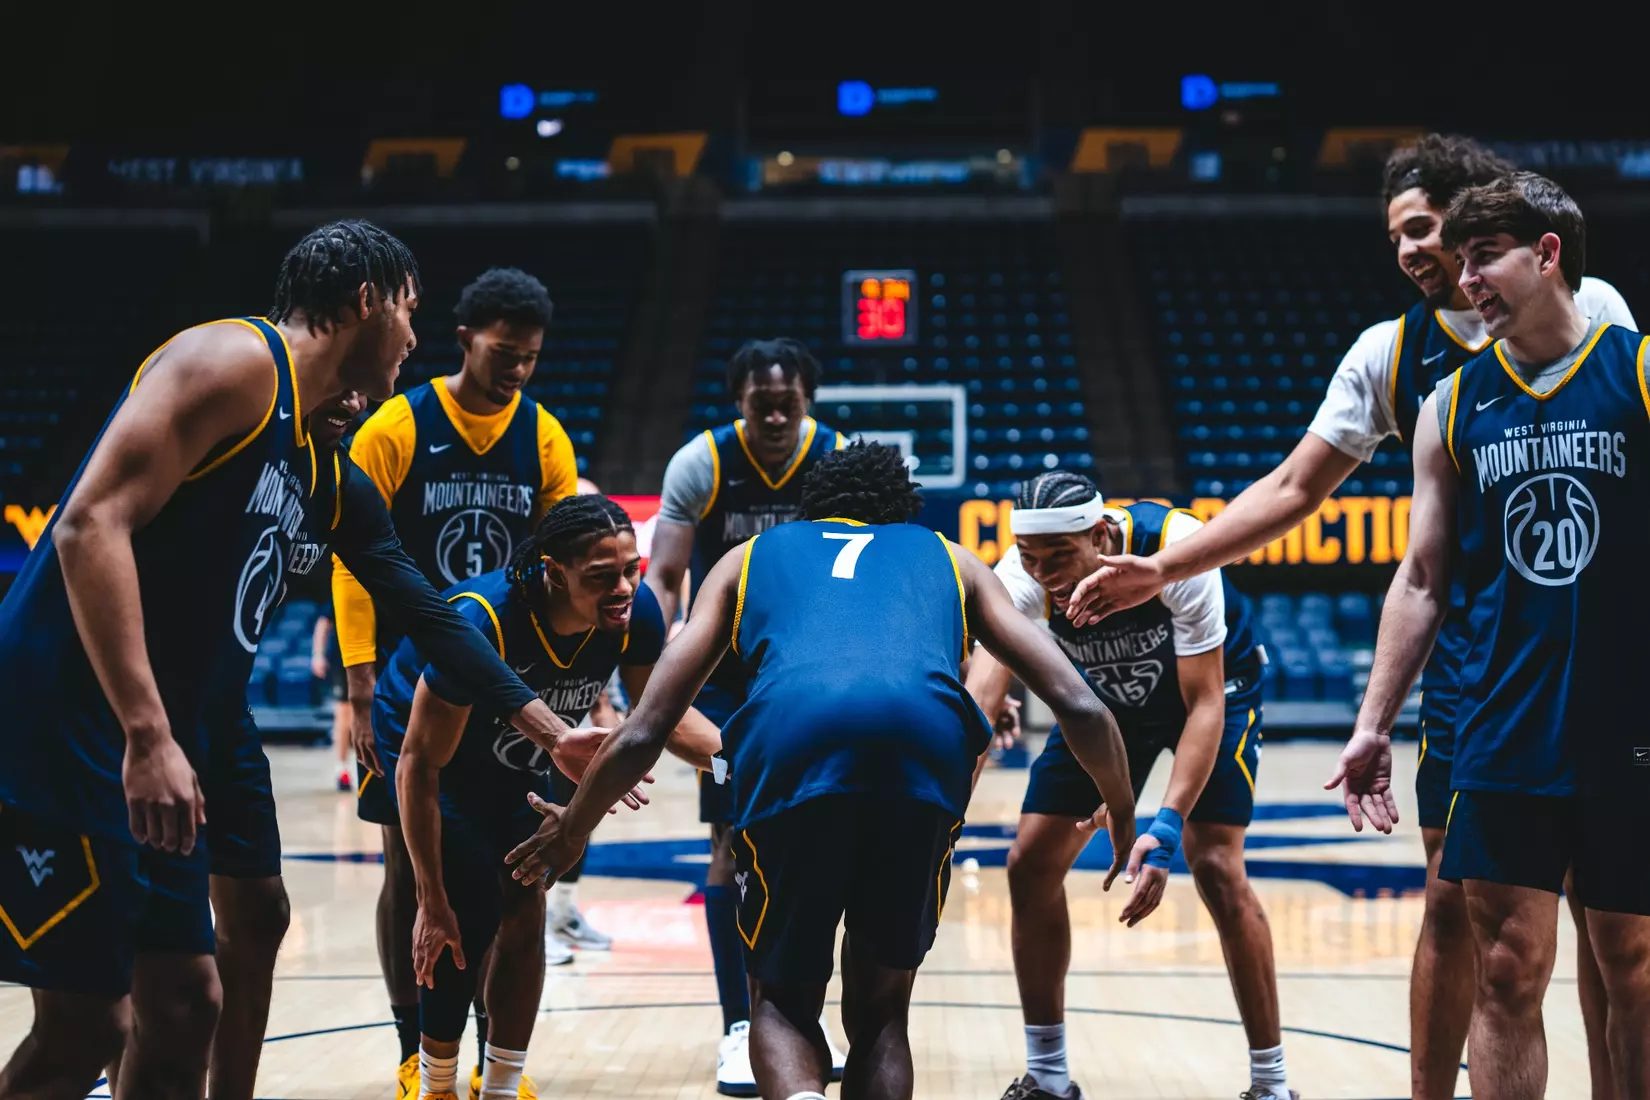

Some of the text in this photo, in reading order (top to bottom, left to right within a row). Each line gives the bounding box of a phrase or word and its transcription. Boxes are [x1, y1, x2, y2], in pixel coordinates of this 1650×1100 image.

[1504, 419, 1587, 439] WEST VIRGINIA
[1472, 431, 1626, 494] MOUNTAINEERS
[422, 481, 534, 518] MOUNTAINEERS
[465, 542, 483, 578] 5
[822, 531, 875, 580] 7
[1532, 518, 1576, 571] 20
[1109, 679, 1146, 701] 15
